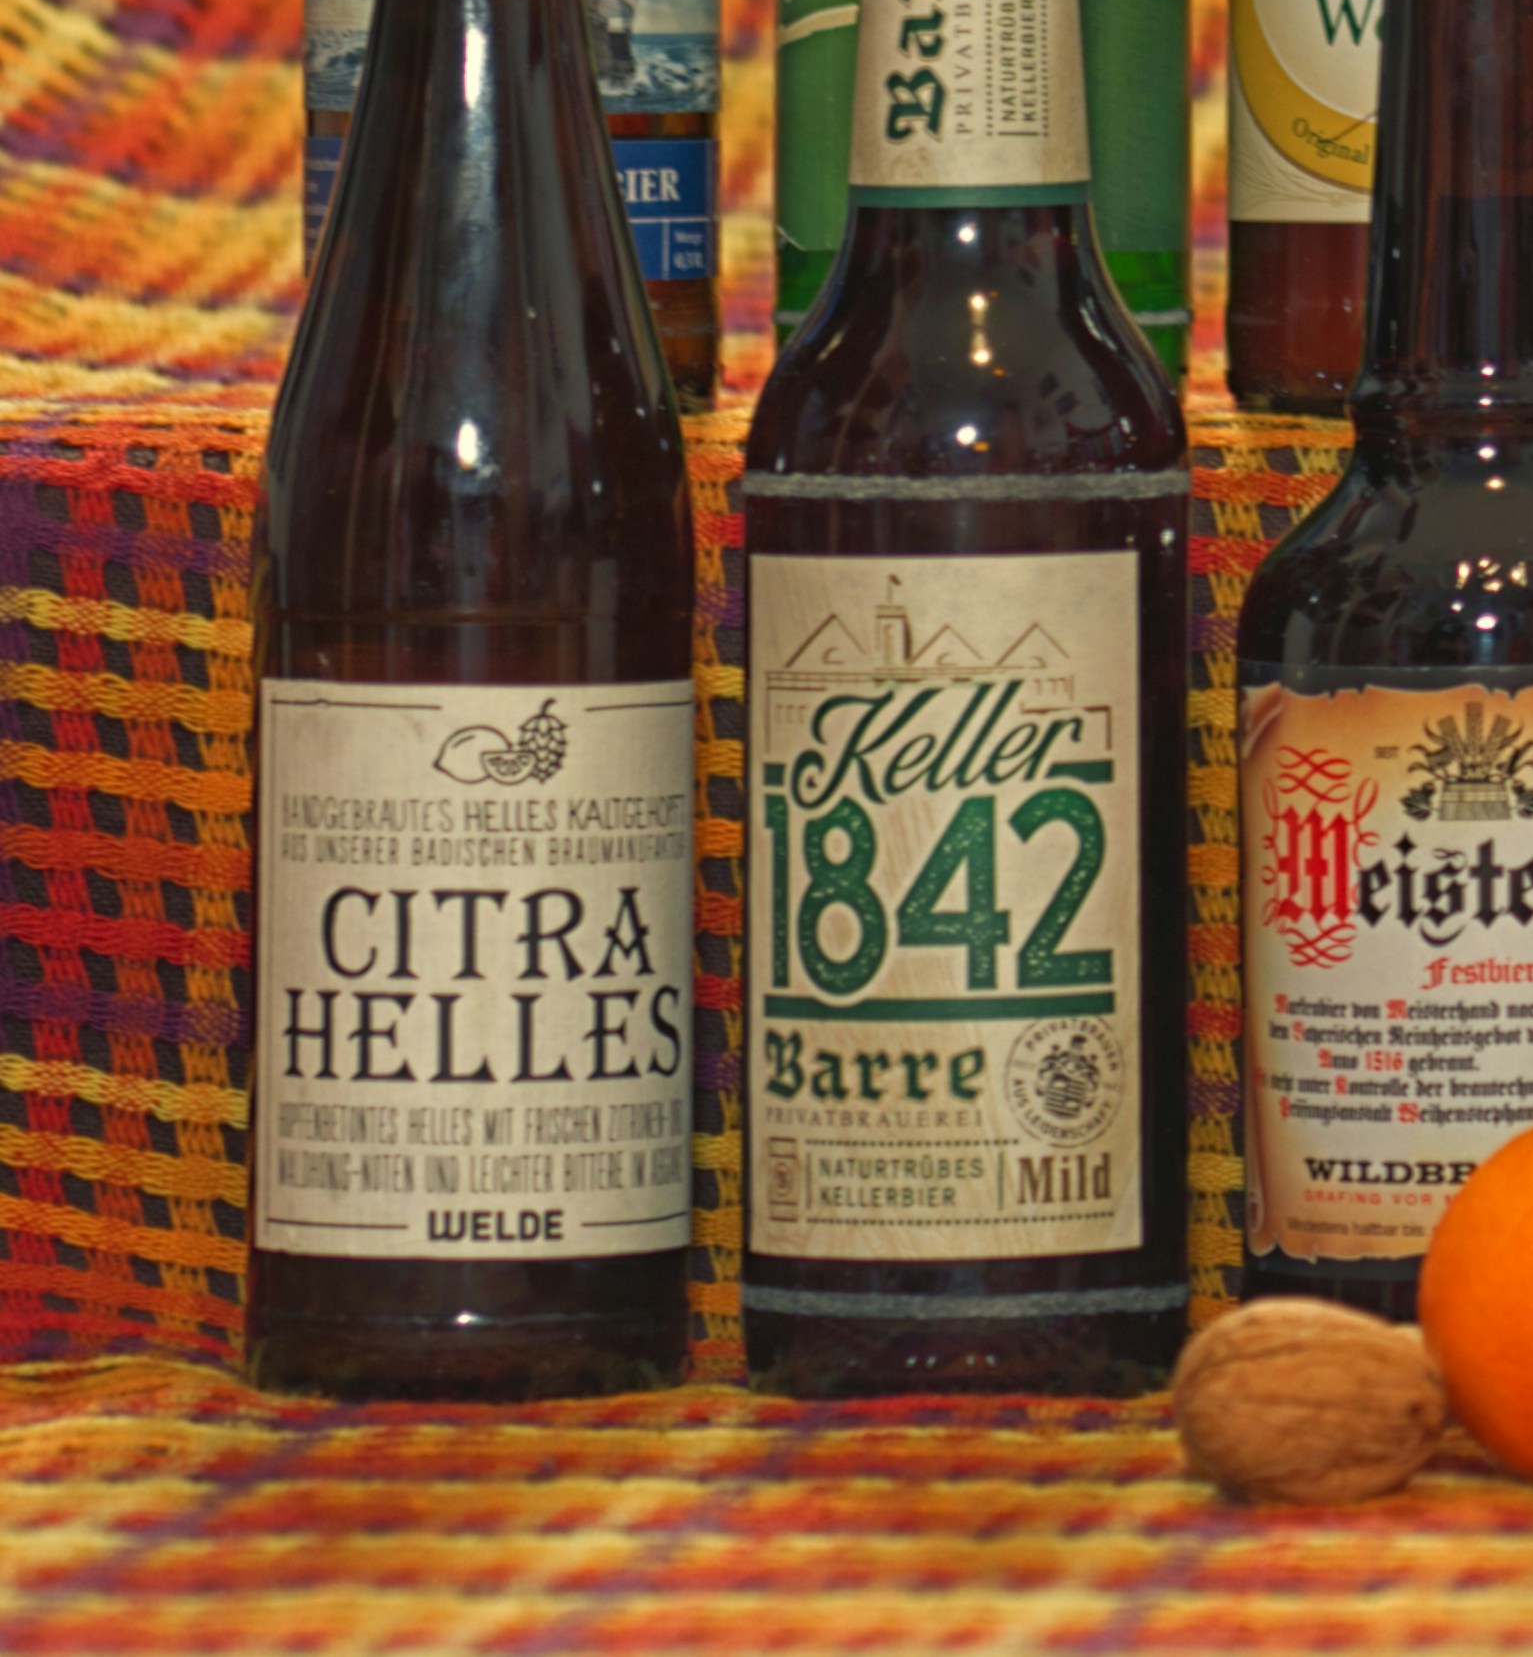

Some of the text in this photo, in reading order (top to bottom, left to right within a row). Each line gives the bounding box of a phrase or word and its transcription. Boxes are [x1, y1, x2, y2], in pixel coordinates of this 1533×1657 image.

[1291, 116, 1371, 167] Original
[790, 678, 1084, 809] Keller
[465, 798, 557, 833] HELLES
[411, 836, 537, 867] BADISCHEN
[764, 785, 1114, 999] 1842
[320, 886, 656, 982] CITRA
[282, 984, 682, 1084] HELLES
[764, 1027, 986, 1104] Barre
[1364, 1050, 1405, 1073] 1516
[407, 1106, 474, 1146] HELLES
[482, 1106, 516, 1146] MIT
[525, 1104, 601, 1144] FRISCHEN
[765, 1105, 985, 1129] PRIVATBRAUEREI
[818, 1152, 985, 1180] NATURTRÜBES
[1016, 1150, 1112, 1207] Mild
[818, 1184, 957, 1209] KELLERBIER
[427, 1209, 564, 1243] WELDE
